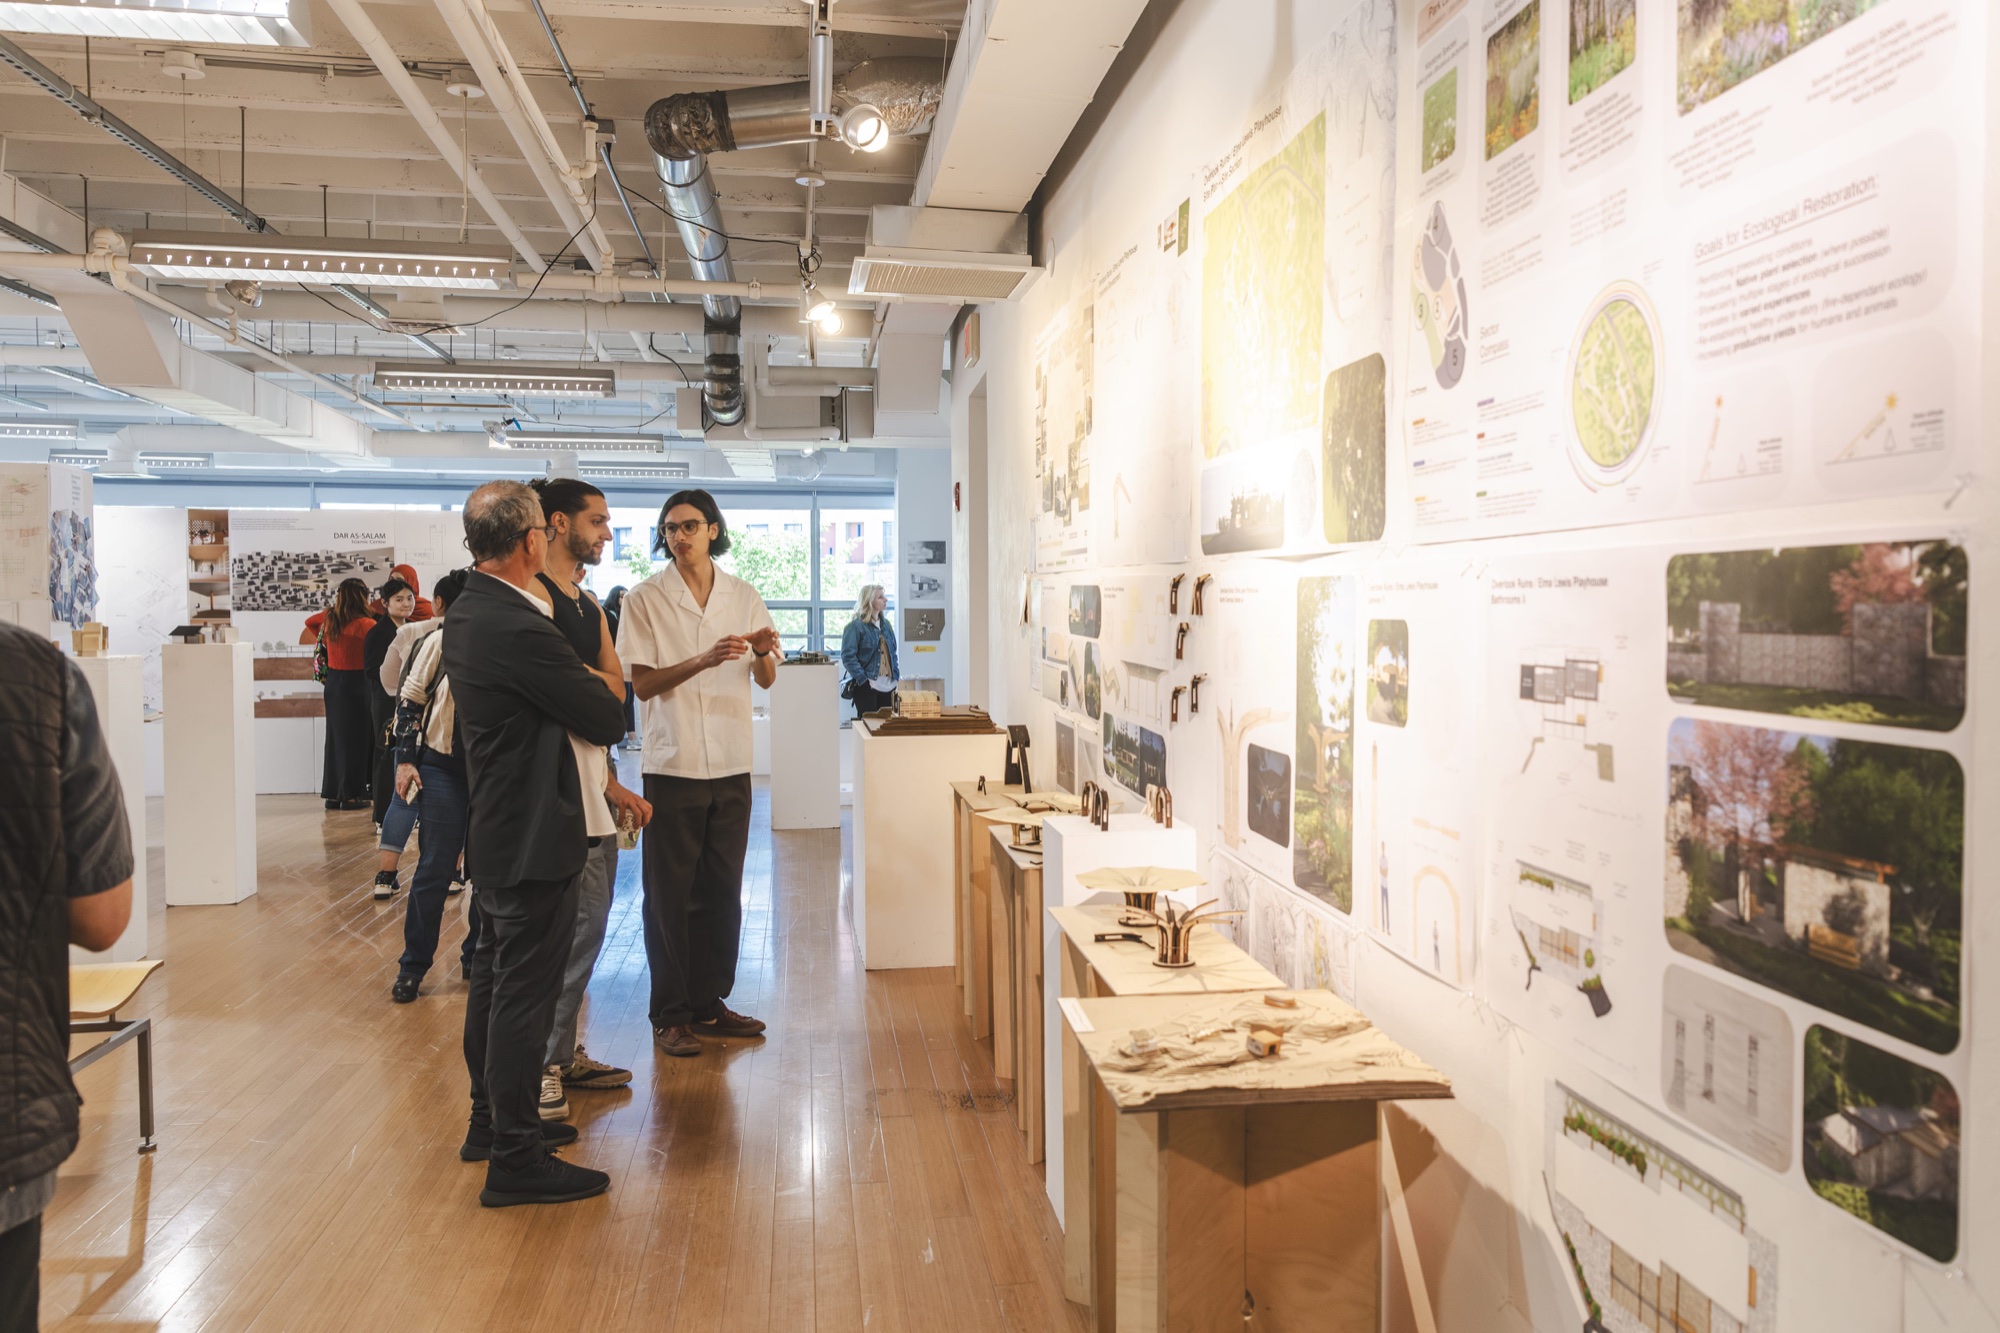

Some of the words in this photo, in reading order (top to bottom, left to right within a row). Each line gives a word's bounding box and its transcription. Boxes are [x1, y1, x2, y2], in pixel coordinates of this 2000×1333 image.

[1253, 104, 1282, 134] Playhouse
[1695, 235, 1724, 260] Goals
[1726, 227, 1740, 247] for
[1743, 202, 1800, 241] Ecological
[1803, 173, 1880, 217] Restoration:
[1781, 251, 1819, 272] selection
[1845, 304, 1863, 322] and
[1479, 323, 1500, 341] Sector
[1479, 339, 1511, 360] Compass
[1572, 575, 1609, 592] Playhouse
